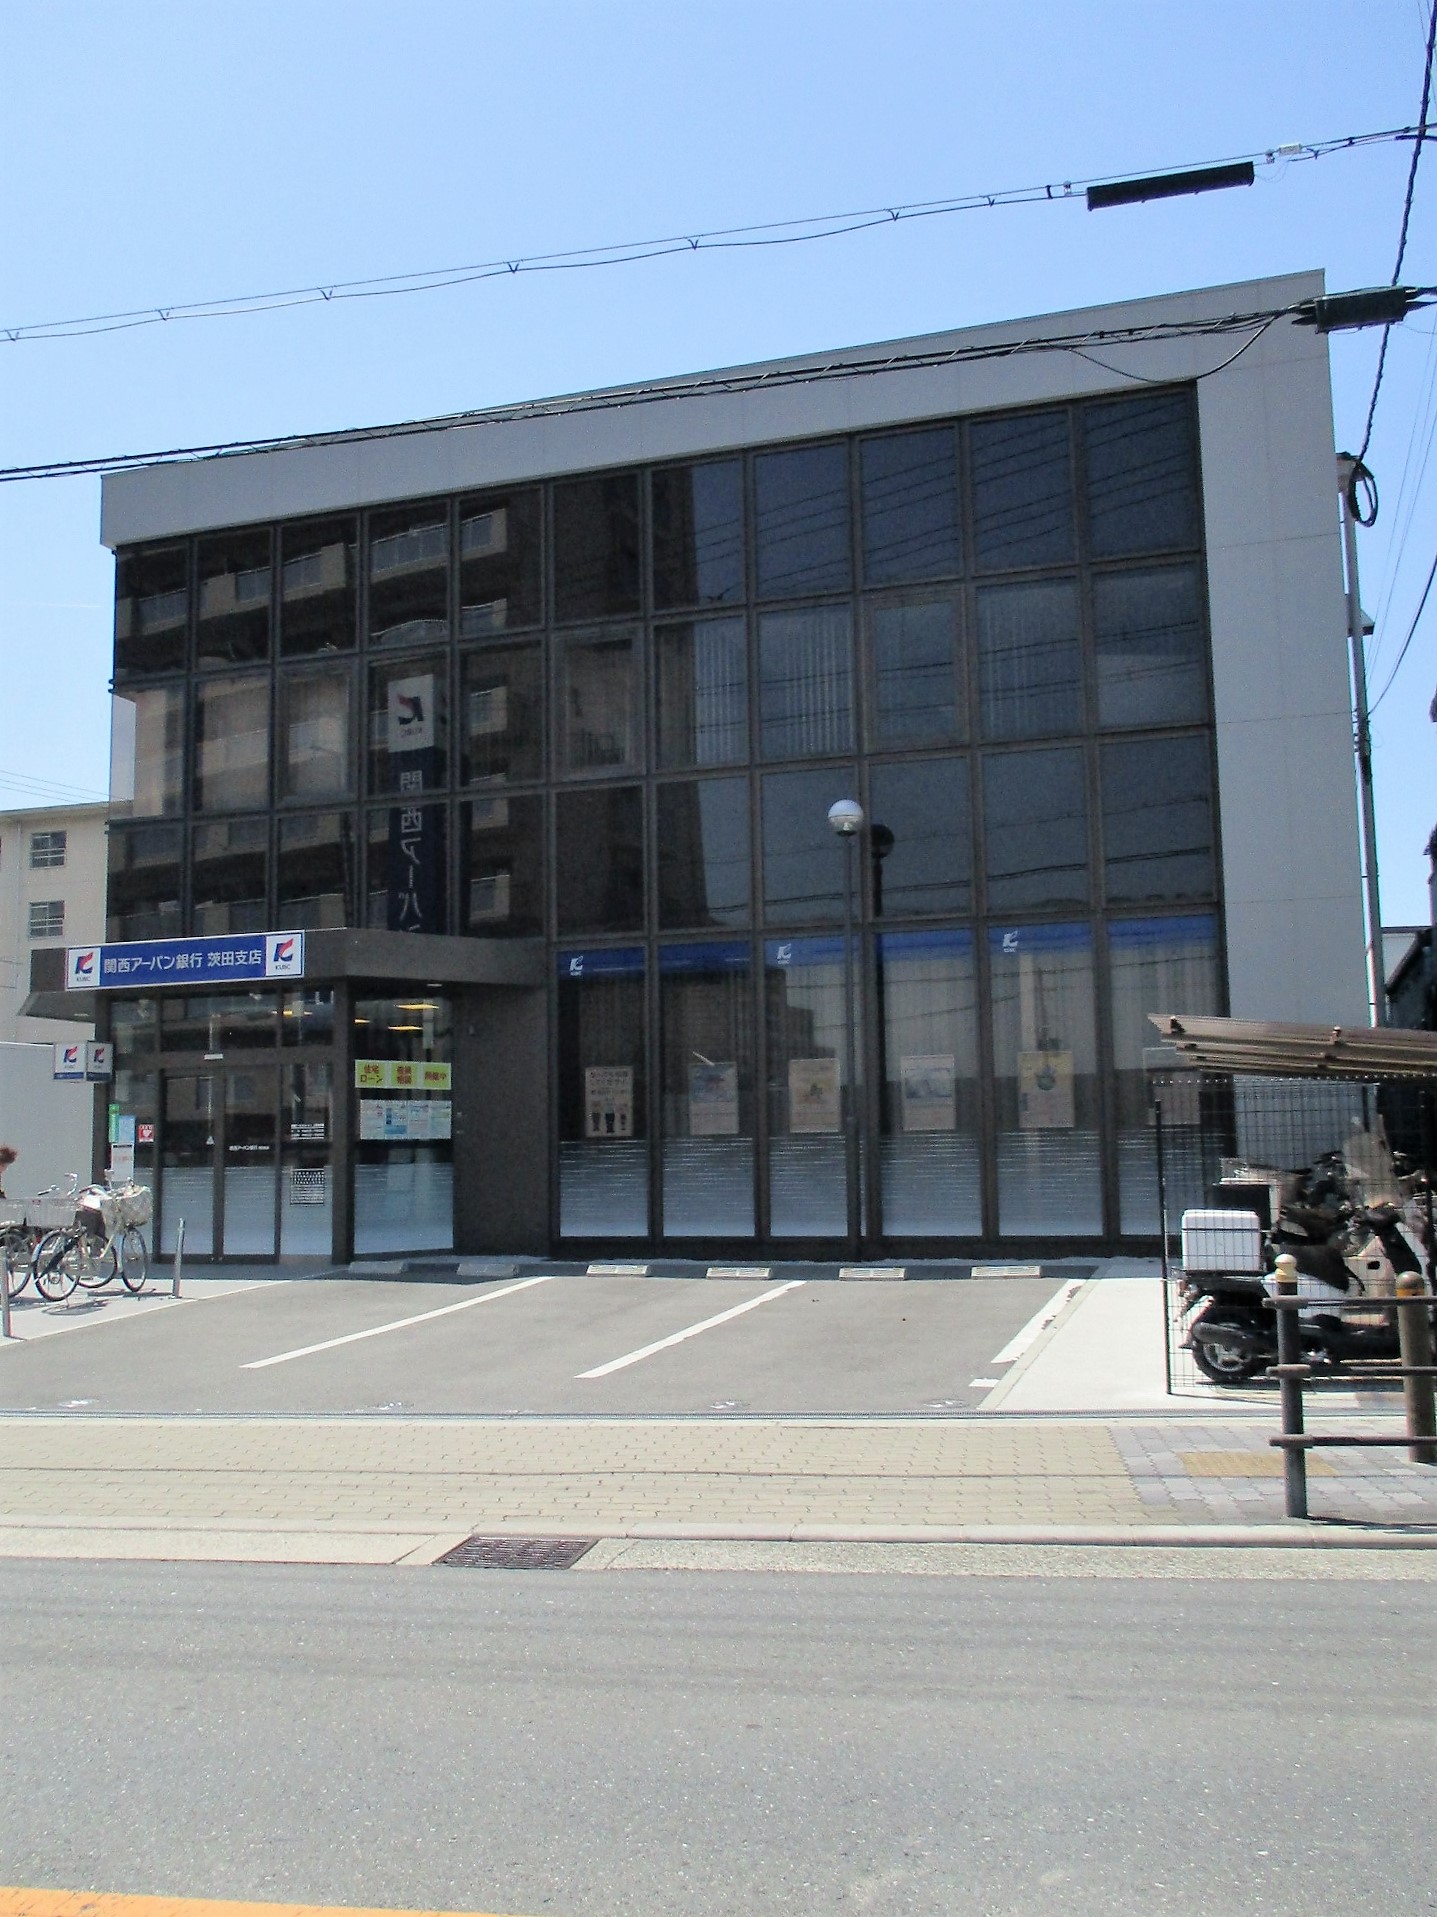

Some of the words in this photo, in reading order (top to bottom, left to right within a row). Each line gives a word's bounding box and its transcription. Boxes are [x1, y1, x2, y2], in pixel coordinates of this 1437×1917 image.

[103, 952, 203, 974] 関西アーバン銀行
[207, 949, 263, 968] 茨田支店
